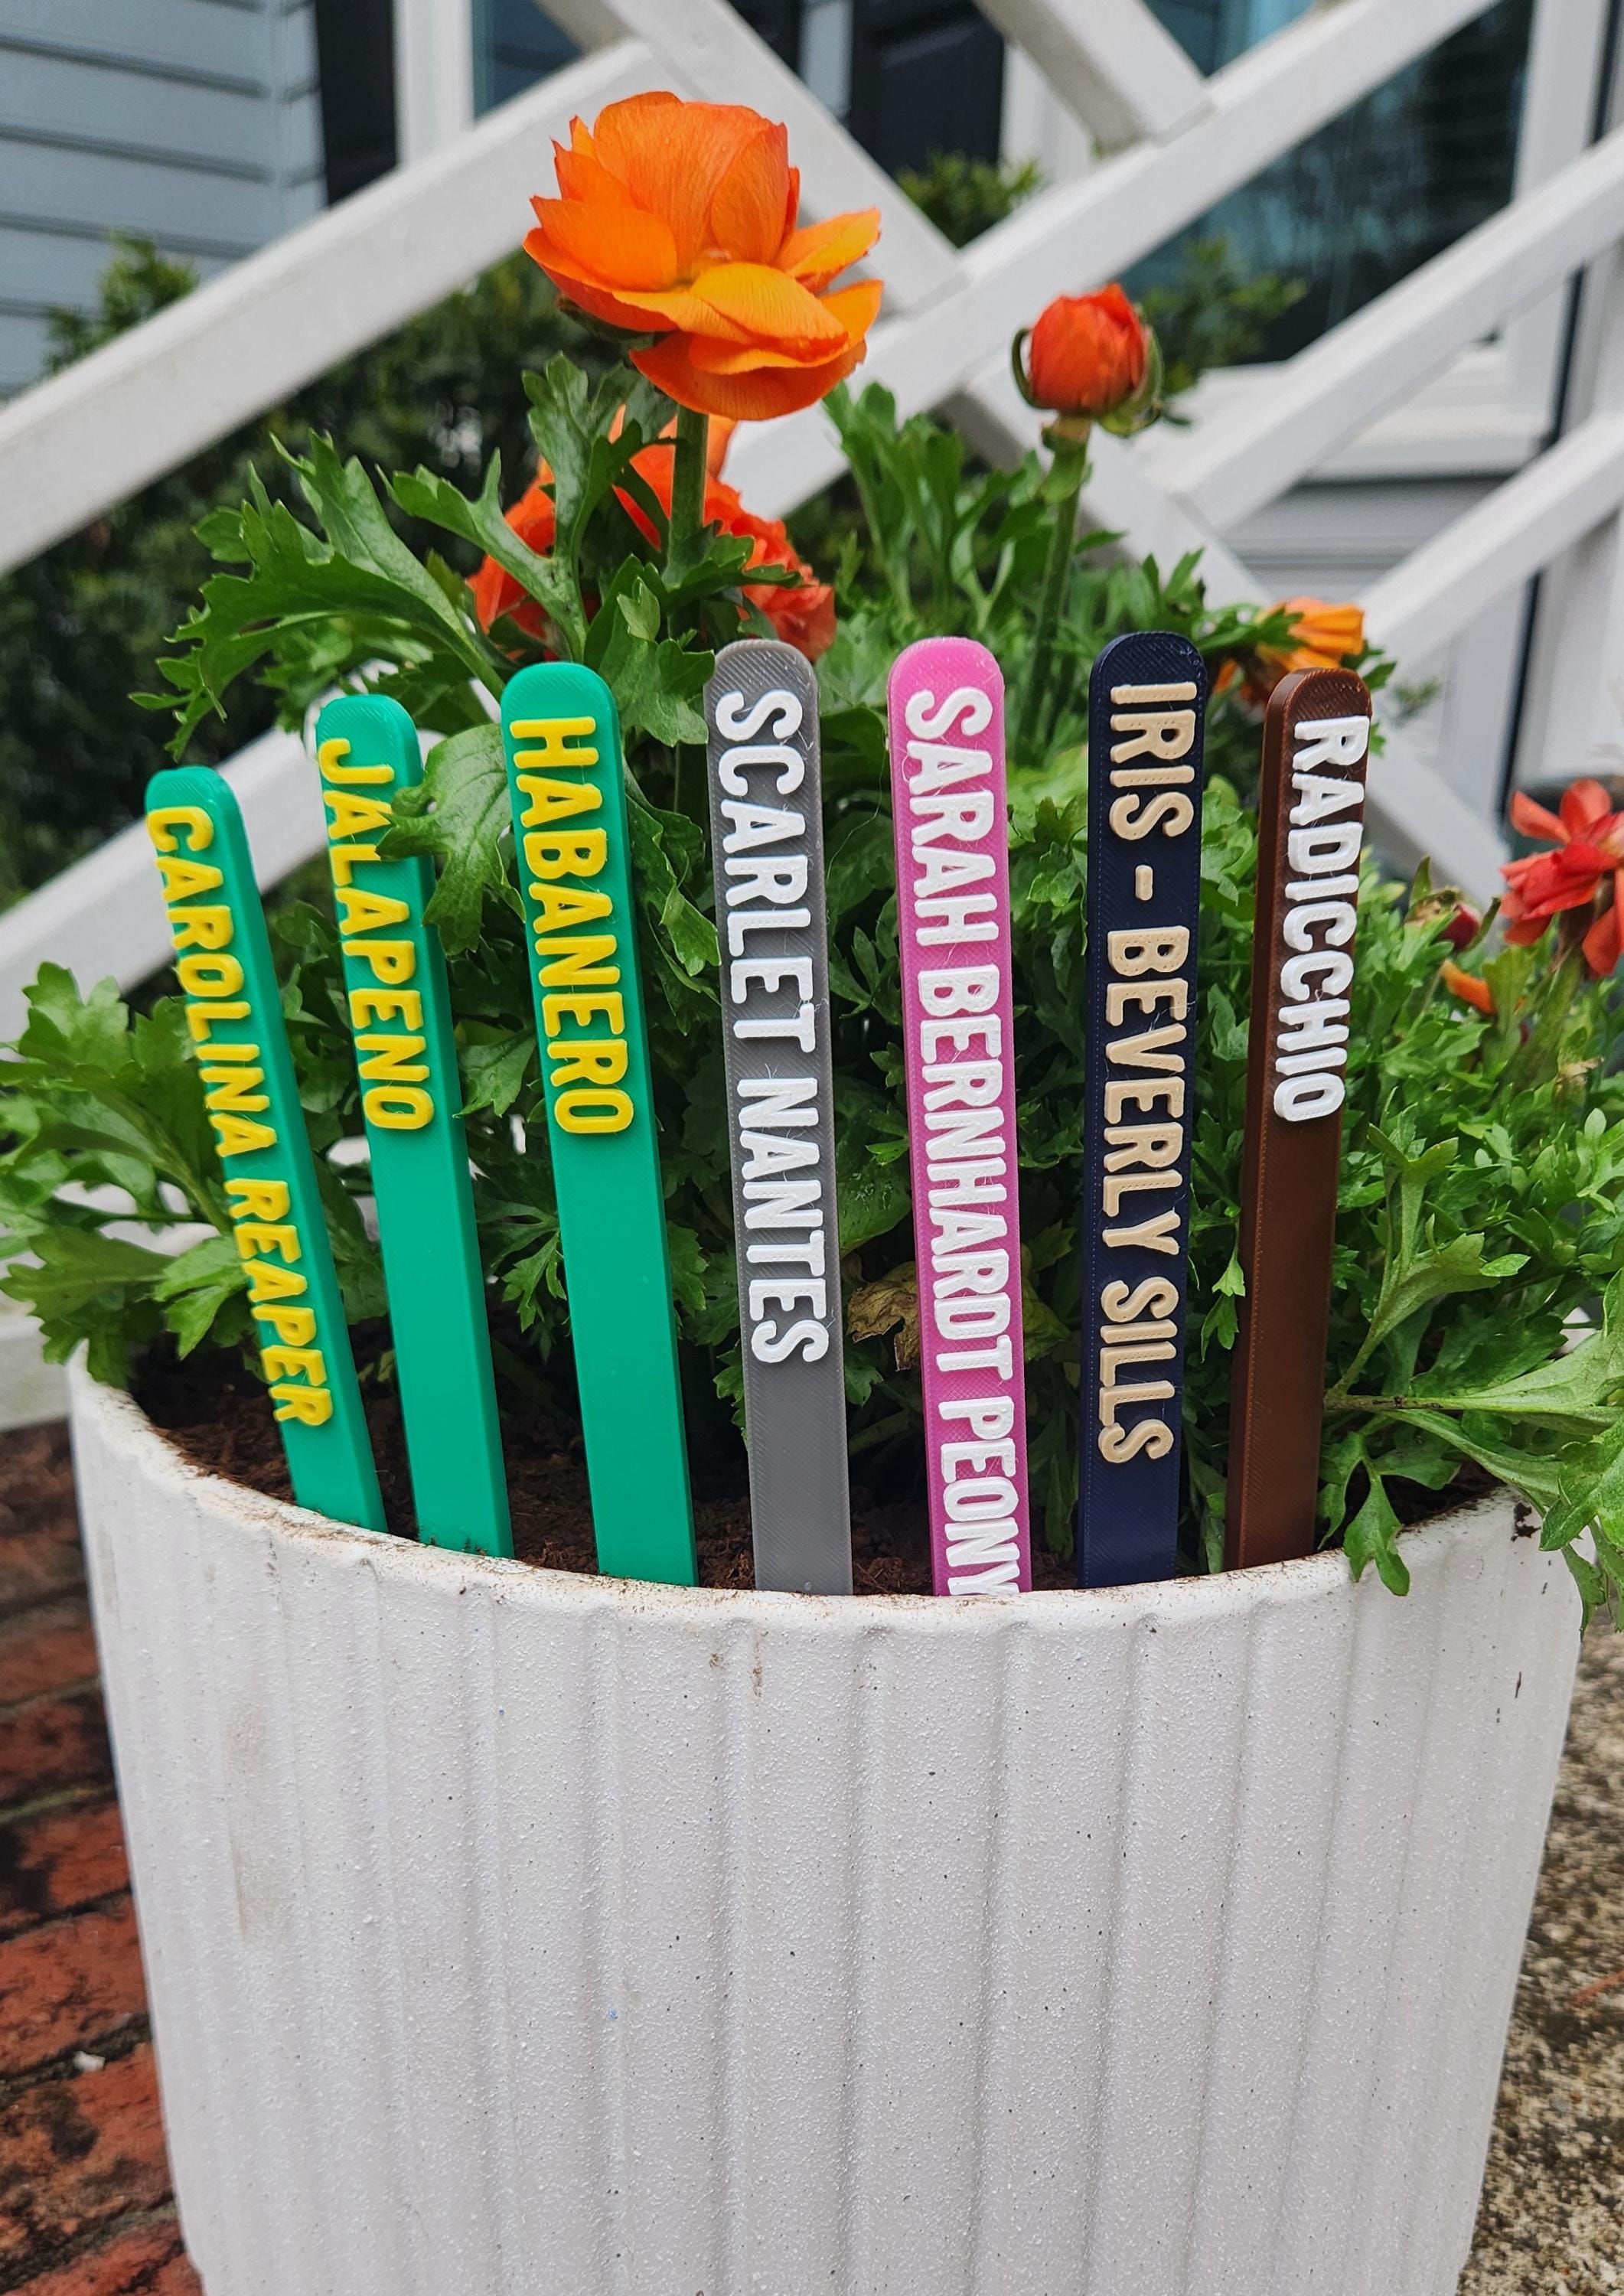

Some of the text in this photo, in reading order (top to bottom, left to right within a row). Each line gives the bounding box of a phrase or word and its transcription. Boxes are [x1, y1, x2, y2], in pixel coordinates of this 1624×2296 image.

[148, 806, 333, 1427] CAROLINA REAPER
[318, 738, 434, 1130] JALAPENO
[510, 716, 634, 1133] HABANERO
[716, 689, 830, 1364] SCARLET NANTES
[905, 689, 1020, 1596] SARAH BERNHARDT PEONY
[1098, 682, 1197, 1464] IRIS - BEVERLY SILLS
[1273, 716, 1371, 1122] RADICCHIO
